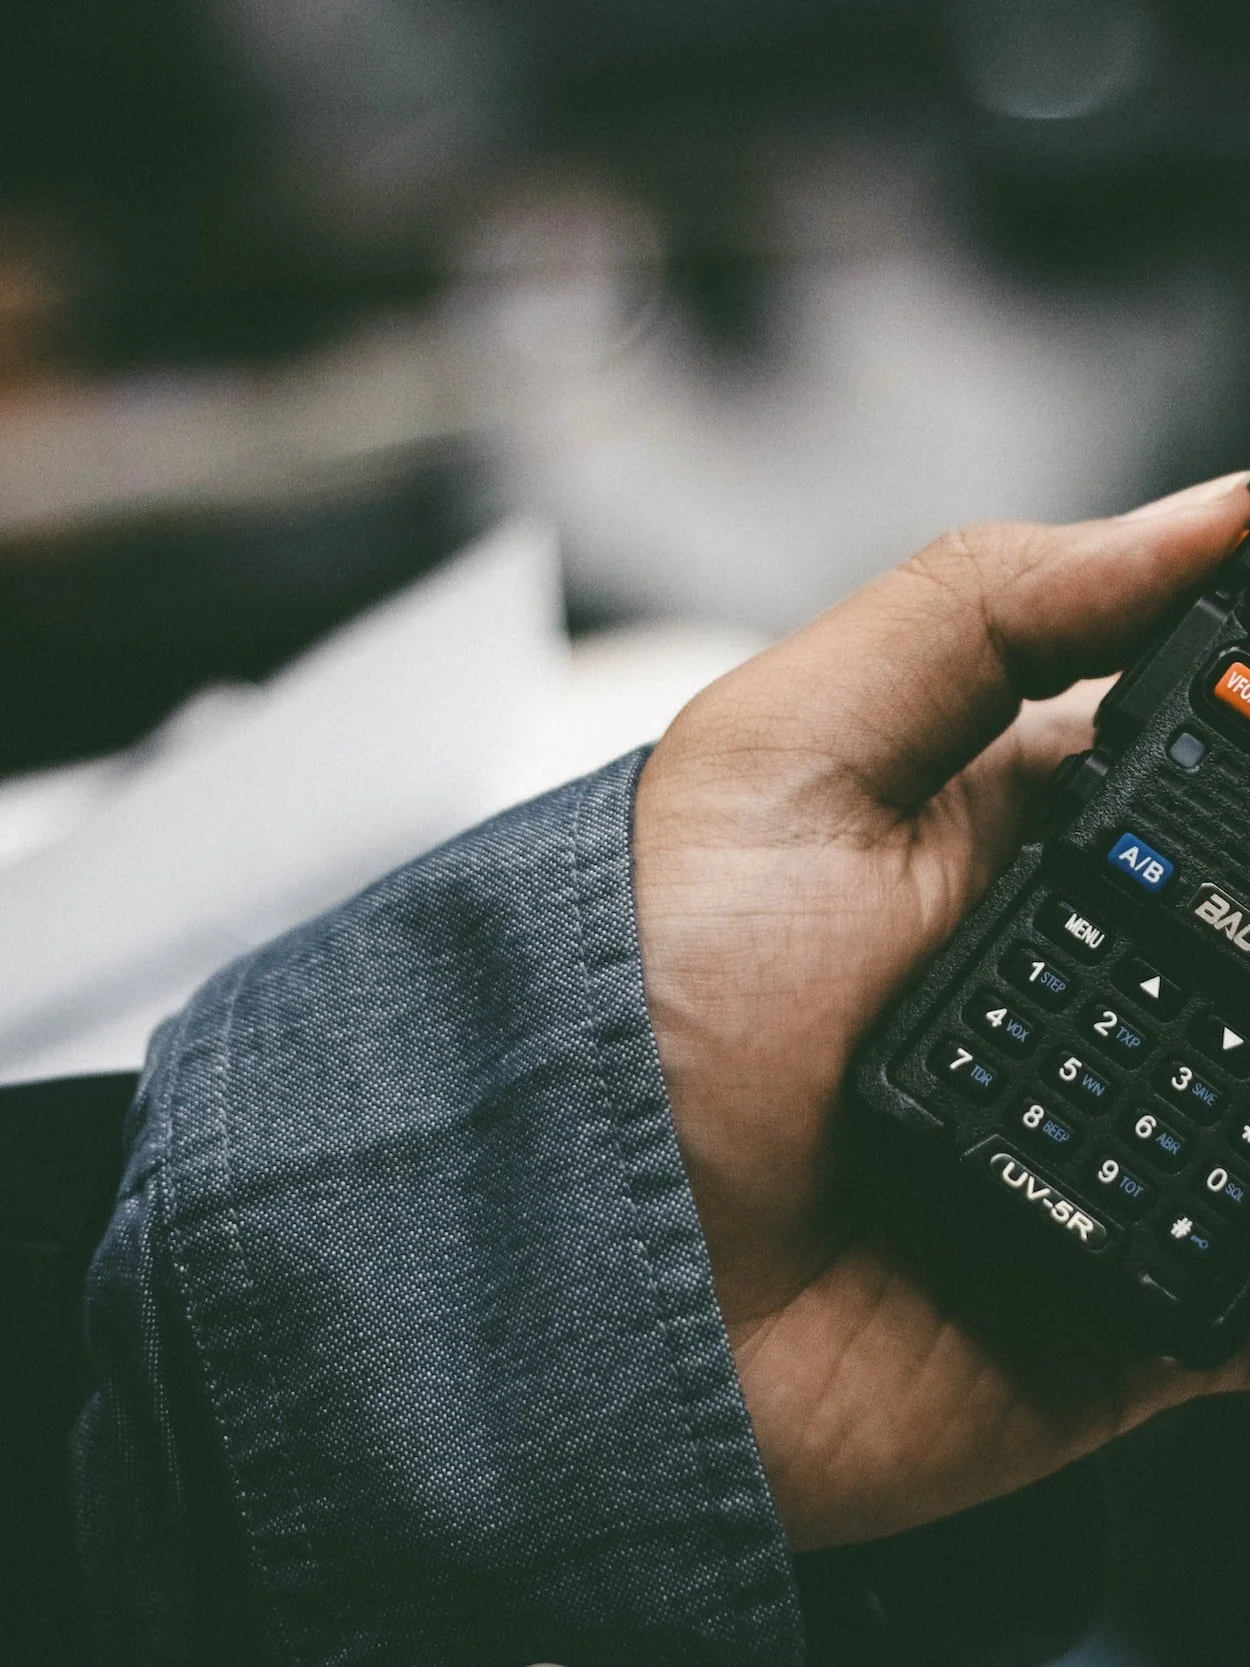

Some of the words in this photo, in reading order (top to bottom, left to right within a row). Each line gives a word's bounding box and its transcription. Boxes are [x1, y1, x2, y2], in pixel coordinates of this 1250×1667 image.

[1118, 846, 1165, 884] A/B
[1064, 912, 1106, 949] MENU
[1028, 961, 1045, 982] 1
[1040, 971, 1067, 993] STEP
[985, 1008, 1008, 1028] 4
[1006, 1018, 1031, 1043] VOX
[1093, 1010, 1118, 1036] 2
[1115, 1027, 1141, 1049] TXP
[949, 1047, 974, 1071] 7
[1058, 1056, 1083, 1082] 5
[1171, 1066, 1193, 1091] 3
[1191, 1082, 1218, 1106] SAVE
[1022, 1104, 1045, 1129] 8
[1042, 1120, 1071, 1143] BEEP
[1135, 1114, 1158, 1139] 6
[1098, 1159, 1120, 1184] 9
[1119, 1175, 1144, 1198] TOT
[1206, 1167, 1229, 1192] 0
[1001, 1161, 1094, 1242] UV-5R
